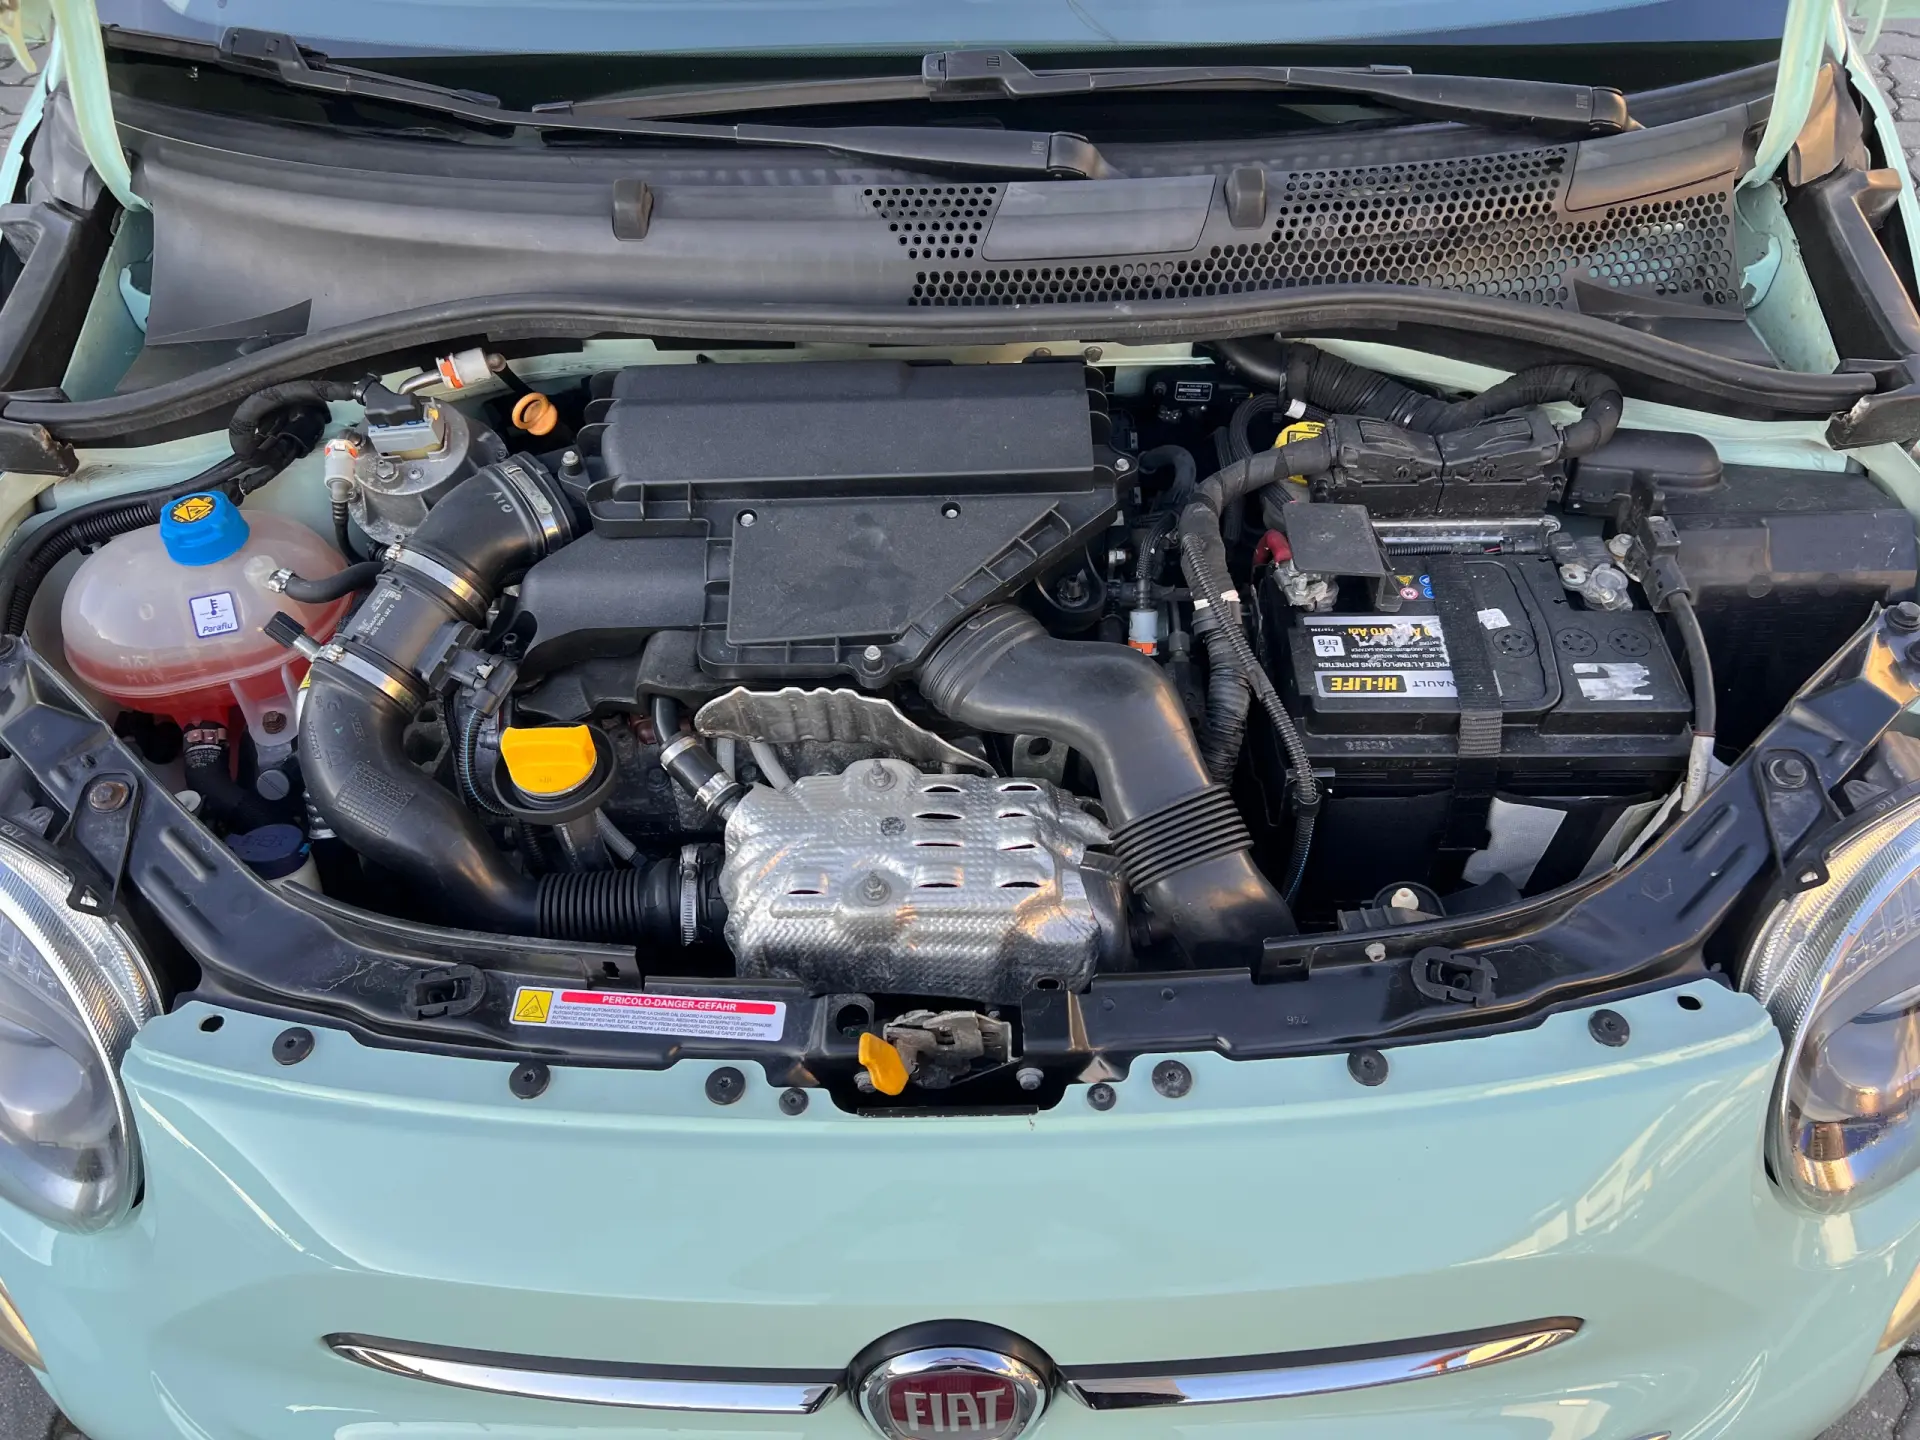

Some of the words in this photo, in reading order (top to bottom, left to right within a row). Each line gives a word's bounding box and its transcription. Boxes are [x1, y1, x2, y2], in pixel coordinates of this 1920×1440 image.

[202, 622, 233, 634] Paraflu
[1426, 661, 1450, 669] PRÊTE
[1330, 677, 1398, 691] Hi-LIFE
[602, 995, 737, 1011] PERICOLO-DANGER-GEFAHR
[903, 1387, 1006, 1433] FIAT
